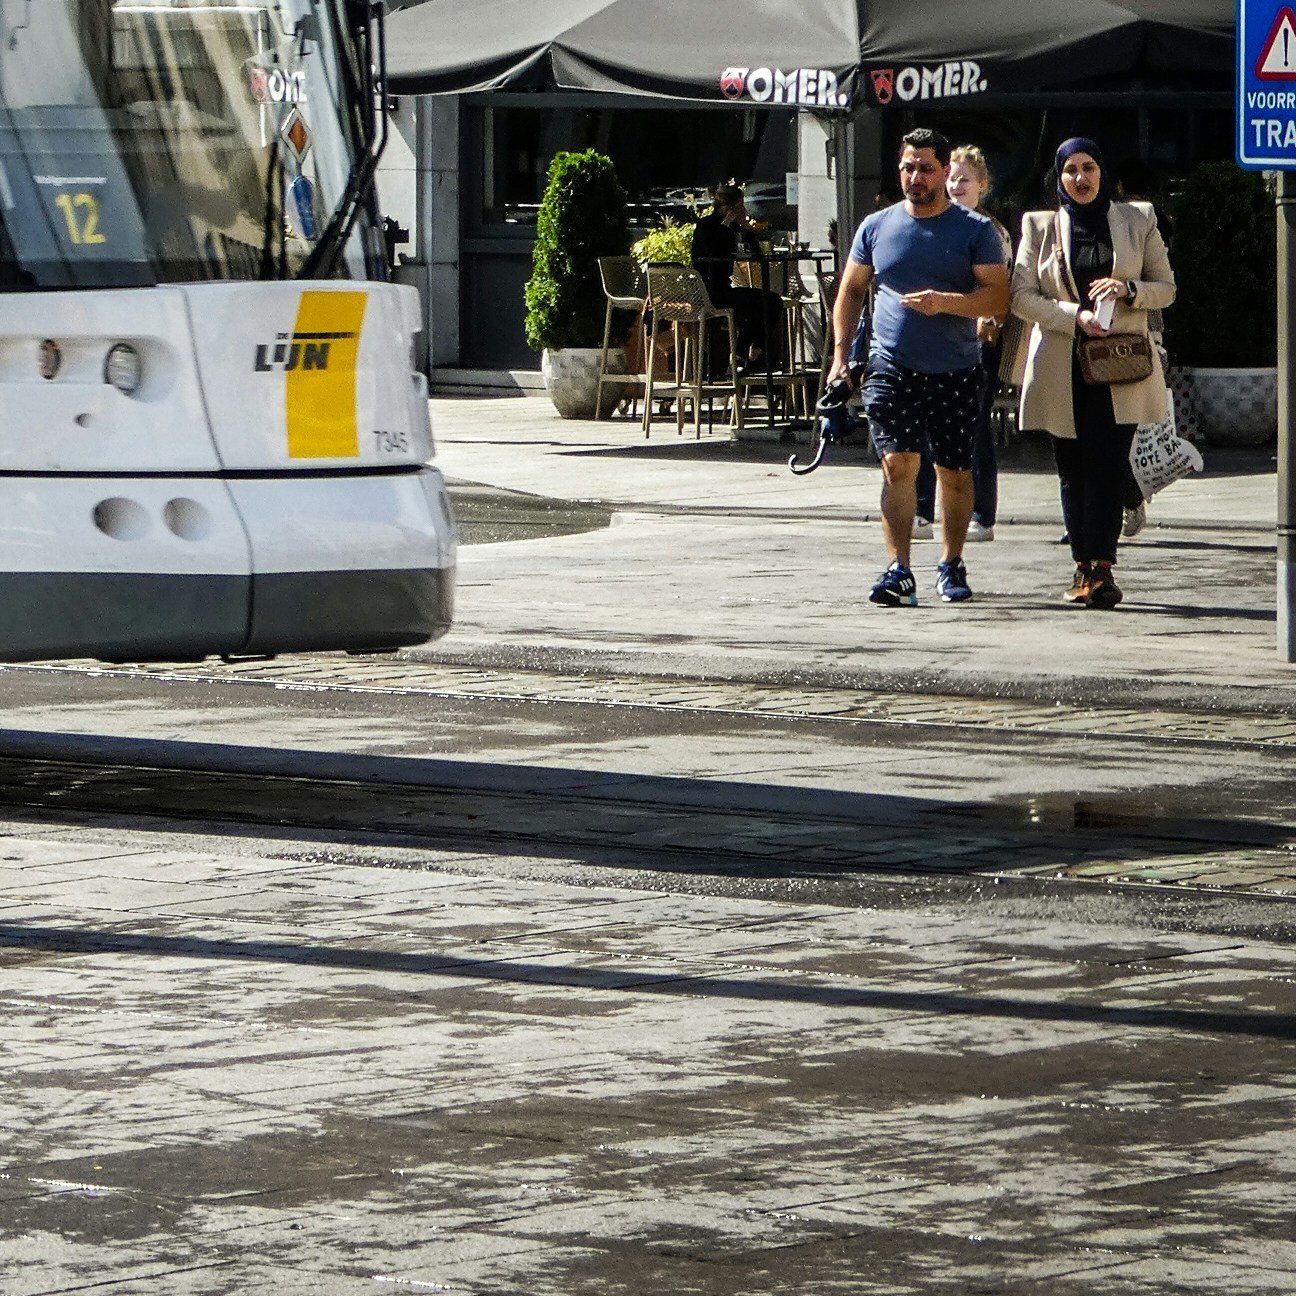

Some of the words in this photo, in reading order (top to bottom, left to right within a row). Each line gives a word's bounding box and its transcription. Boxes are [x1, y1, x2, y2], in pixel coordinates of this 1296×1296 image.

[54, 193, 107, 244] 12
[254, 342, 331, 372] LIJN
[1134, 454, 1161, 470] TOTE
